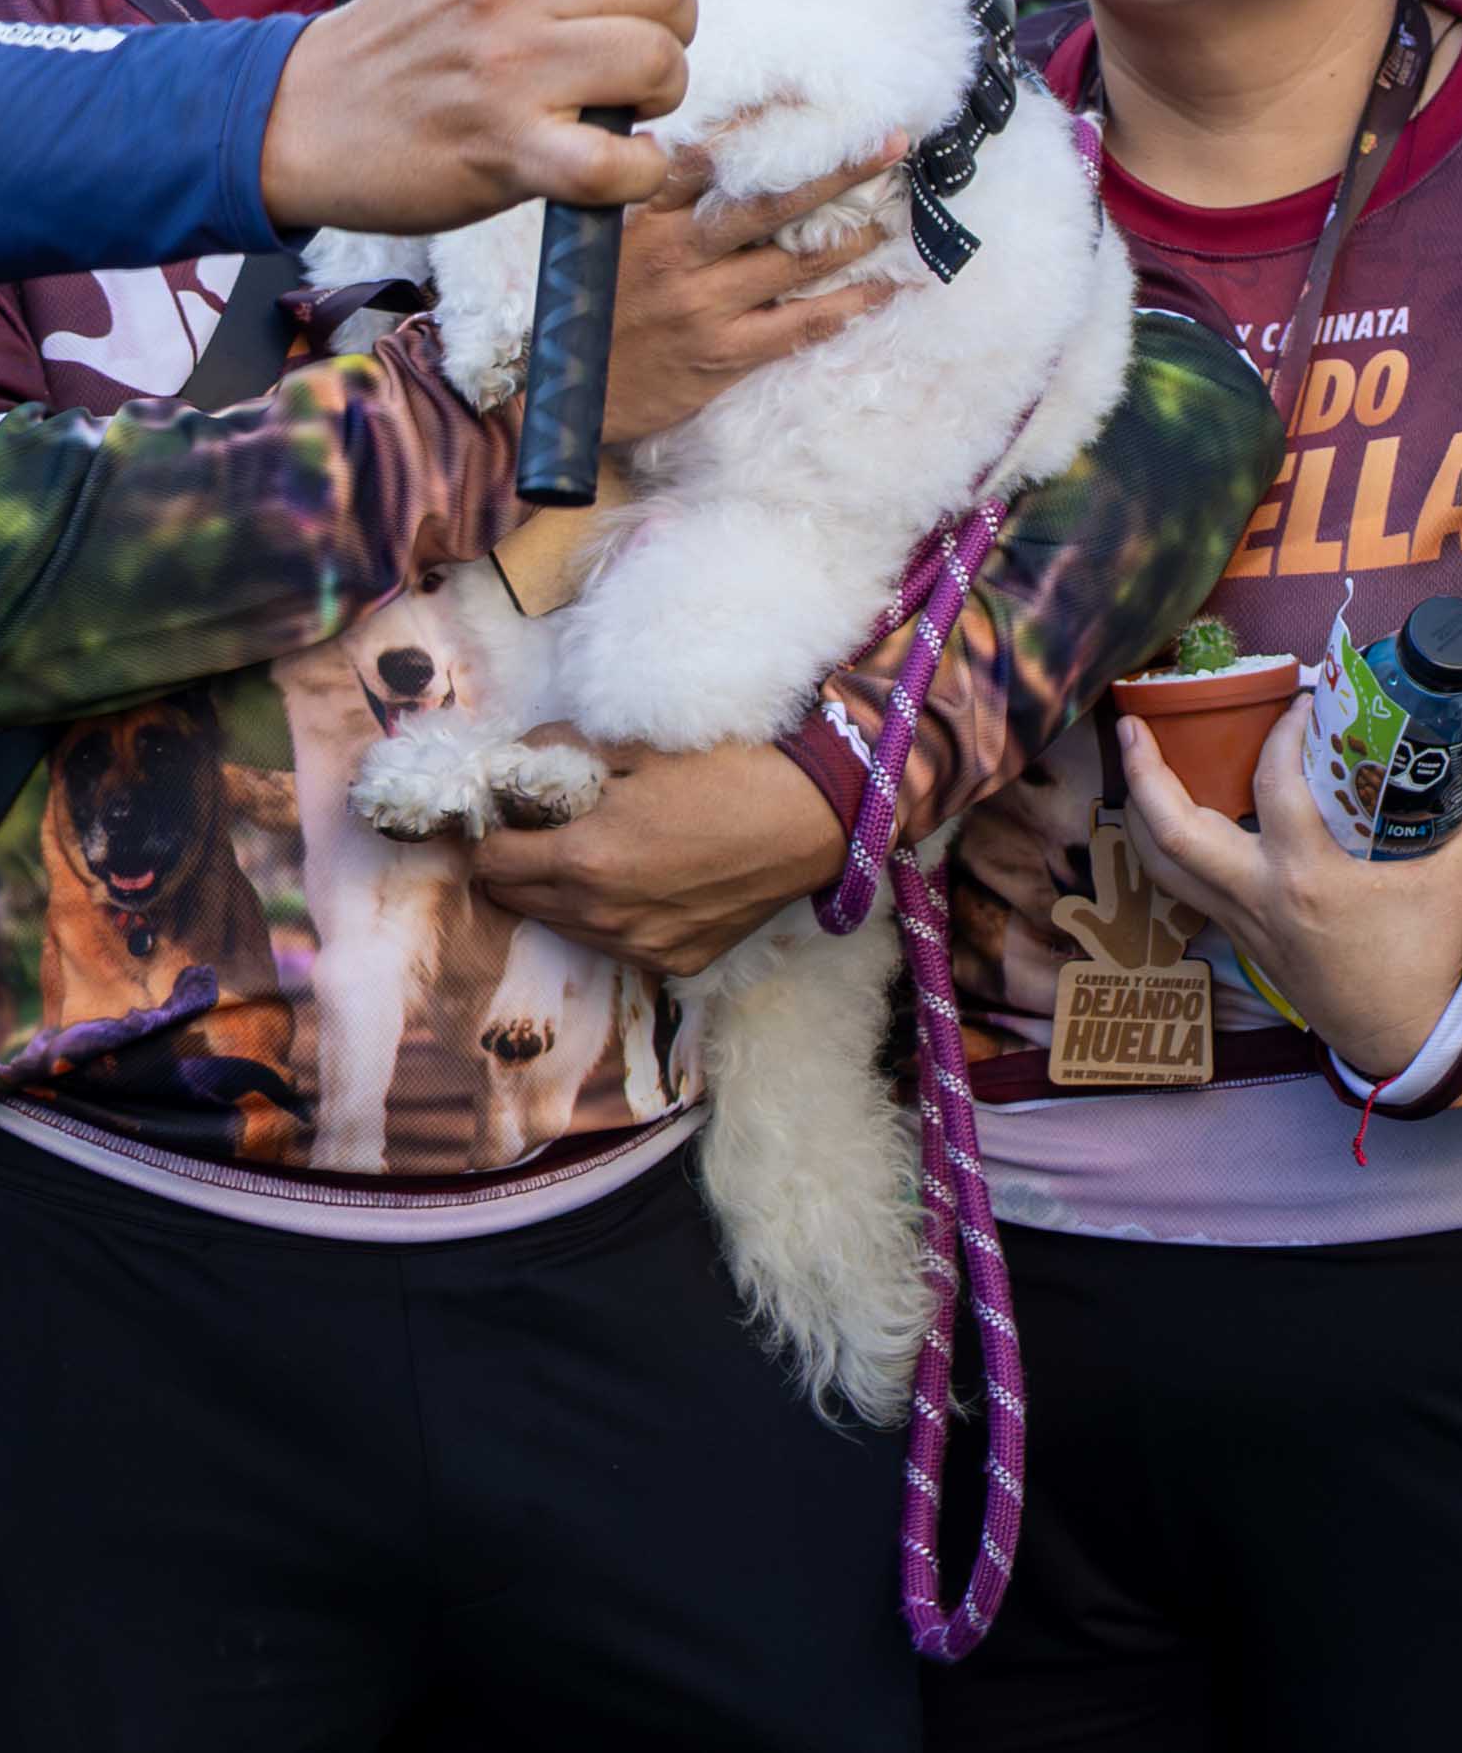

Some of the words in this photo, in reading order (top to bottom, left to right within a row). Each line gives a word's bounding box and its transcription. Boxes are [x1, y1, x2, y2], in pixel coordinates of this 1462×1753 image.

[1234, 323, 1253, 344] Y
[1074, 973, 1130, 988] CARRERA
[1134, 975, 1142, 988] Y
[1144, 976, 1206, 991] CAMINATA
[1068, 987, 1205, 1022] DEJANDO
[1061, 1019, 1205, 1067] HUELLA
